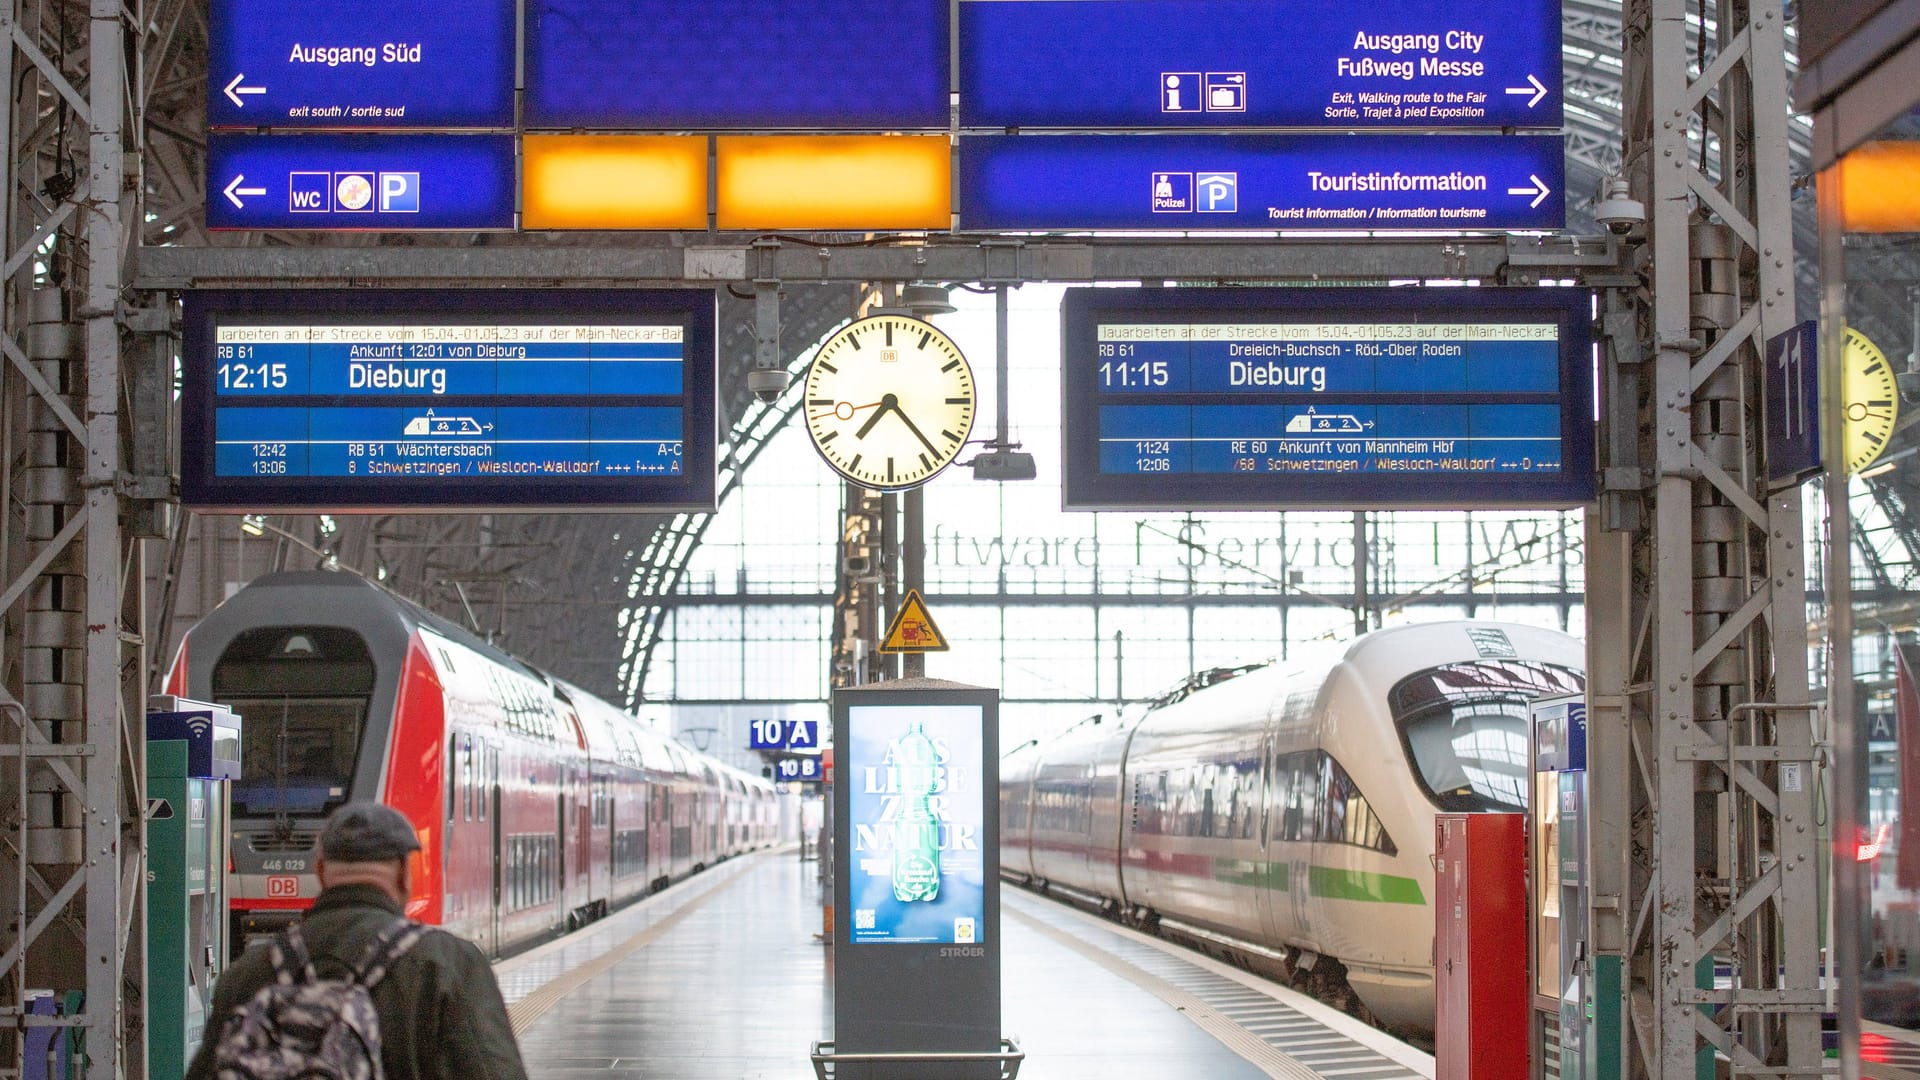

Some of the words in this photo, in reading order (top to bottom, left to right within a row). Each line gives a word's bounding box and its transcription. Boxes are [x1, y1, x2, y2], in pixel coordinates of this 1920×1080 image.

[1354, 31, 1439, 54] Ausgang
[1445, 31, 1484, 54] City
[289, 43, 376, 67] Ausgang
[382, 42, 421, 63] Süd
[1337, 58, 1414, 81] Fußweg
[1420, 58, 1484, 77] Messe
[1331, 92, 1355, 105] Exit,
[1358, 92, 1401, 106] Walking
[1403, 92, 1431, 103] route
[1433, 92, 1444, 103] to
[1447, 92, 1464, 103] the
[1466, 91, 1488, 103] Fair
[289, 105, 309, 117] exit
[312, 105, 341, 117] south
[344, 105, 350, 118] /
[352, 105, 382, 117] sortie
[385, 105, 405, 117] sud
[1324, 107, 1360, 119] Sortie,
[1362, 107, 1392, 119] Trajet
[1395, 107, 1402, 117] à
[1404, 107, 1427, 119] pied
[1429, 107, 1485, 119] Exposition
[1307, 171, 1487, 192] Touristinformation
[292, 190, 321, 208] WC
[382, 174, 407, 209] P
[1209, 184, 1227, 209] P
[1155, 198, 1186, 208] Polizei
[1268, 207, 1304, 219] Tourist
[1306, 207, 1366, 219] information
[1368, 207, 1375, 219] /
[1377, 206, 1437, 219] Information
[1440, 206, 1487, 218] tourisme
[222, 329, 278, 340] arbeiten
[285, 331, 299, 340] an
[305, 328, 325, 340] der
[332, 329, 381, 340] Strecke
[388, 331, 414, 340] vom
[422, 329, 518, 340] 15.04.-01.05.23
[524, 329, 543, 340] auf
[550, 329, 569, 340] der
[1103, 327, 1175, 338] auarbeiten
[1181, 328, 1195, 338] an
[1202, 327, 1221, 338] der
[1227, 327, 1277, 338] Strecke
[1283, 328, 1309, 338] vom
[1317, 326, 1412, 338] 15.04.-01.05.23
[1417, 326, 1437, 337] auf
[1443, 326, 1462, 337] der
[218, 346, 234, 358] RB
[239, 346, 253, 358] 61
[350, 345, 402, 358] Ankunft
[410, 345, 442, 358] 12:01
[449, 348, 472, 357] von
[477, 345, 526, 359] Dieburg
[883, 352, 895, 360] DB
[1099, 344, 1114, 356] RB
[1119, 344, 1134, 356] 61
[1229, 344, 1340, 356] Dreieich-Buchsch
[1355, 343, 1417, 356] Röd.-Ober
[1423, 343, 1461, 356] Roden
[218, 363, 287, 388] 12:15
[349, 364, 446, 394] Dieburg
[1099, 361, 1169, 386] 11:15
[1230, 361, 1326, 392] Dieburg
[1778, 330, 1804, 440] 11
[252, 444, 287, 457] 12:42
[348, 444, 364, 456] RB
[396, 443, 492, 456] Wächtersbach
[657, 443, 682, 456] A-C
[1135, 441, 1169, 453] 11:24
[1231, 441, 1247, 454] RE
[1252, 441, 1267, 454] 60
[1278, 441, 1332, 454] Ankunft
[1337, 443, 1360, 454] von
[1365, 441, 1428, 454] Mannheim
[1433, 441, 1455, 454] Hbf
[252, 461, 286, 473] 13:06
[368, 460, 460, 475] Schwetzingen
[477, 460, 600, 473] Wiesloch-Walldorf
[1136, 458, 1170, 471] 12:06
[1267, 458, 1358, 473] Schwetzingen
[1374, 458, 1496, 471] Wiesloch-Walldorf
[900, 523, 1099, 567] ftware
[752, 720, 782, 744] 10
[790, 721, 811, 744] A
[1872, 714, 1890, 737] A
[779, 759, 799, 776] 10
[802, 759, 815, 776] B
[863, 766, 969, 794] LIBE
[855, 823, 978, 851] NATUR
[262, 860, 281, 871] 446
[285, 860, 306, 871] 029
[271, 879, 296, 894] DB
[939, 946, 984, 957] STRÖER
